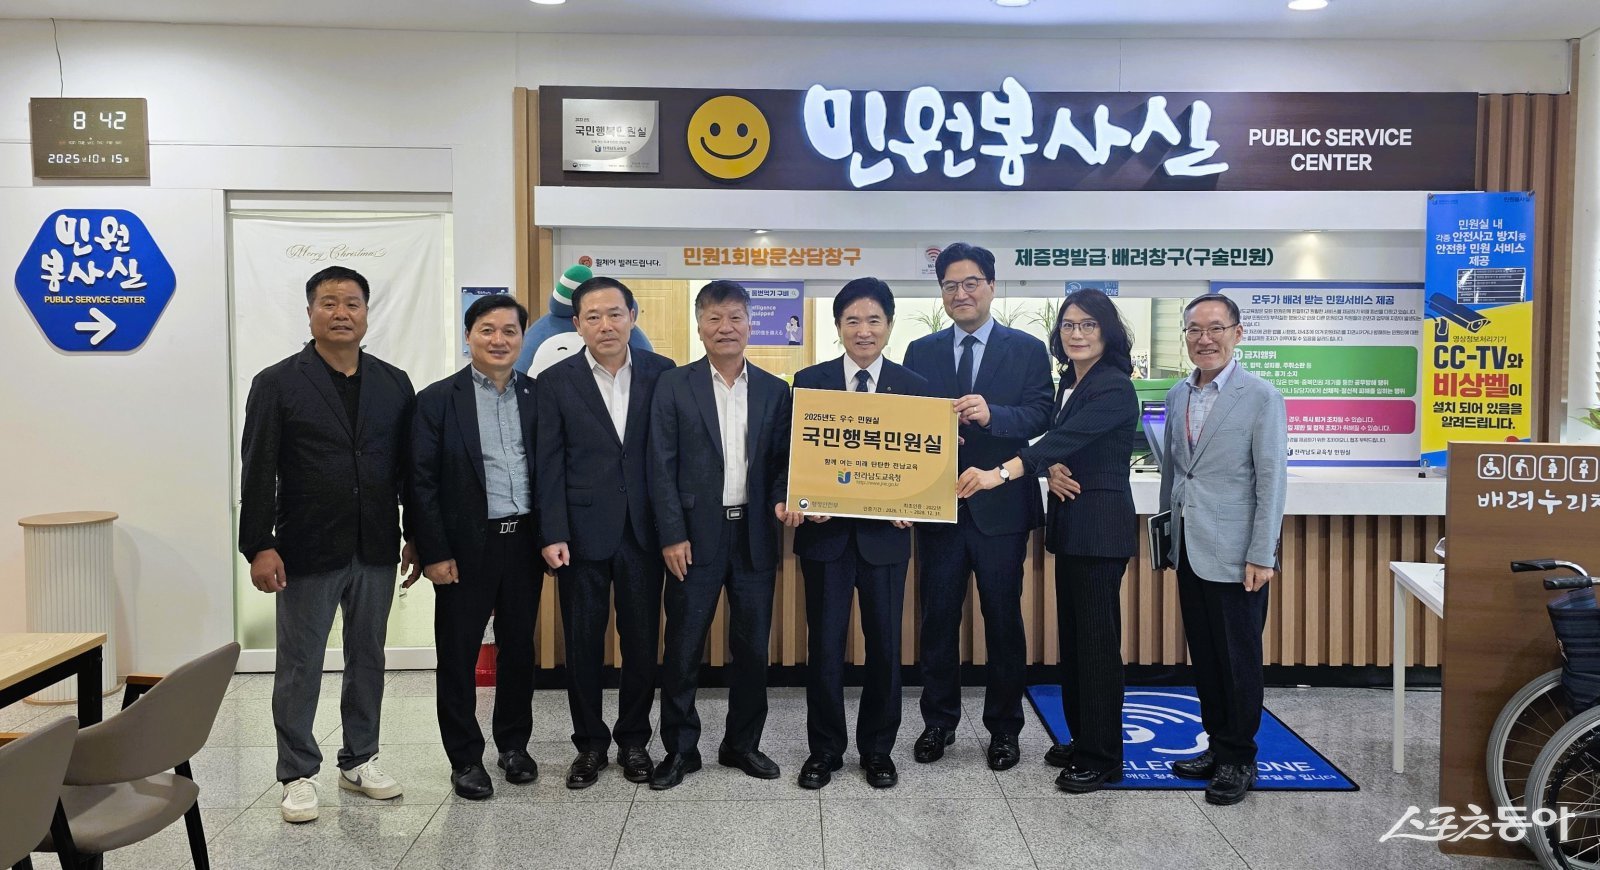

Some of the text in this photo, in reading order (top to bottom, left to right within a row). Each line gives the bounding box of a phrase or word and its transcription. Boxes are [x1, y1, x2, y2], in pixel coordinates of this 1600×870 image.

[73, 111, 127, 130] 8 42
[803, 76, 1229, 188] 민원봉사실
[1248, 128, 1412, 146] PUBLIC SERVICE
[1291, 153, 1372, 171] CENTER
[1458, 218, 1503, 230] 민원실 내
[55, 215, 130, 257] 민원
[1452, 231, 1494, 242] 안전사고
[286, 244, 388, 264] Merry Christmas
[1435, 243, 1526, 255] 안전한 민원 서비스
[595, 258, 661, 267] 휠체어 빌려드립니다.
[683, 247, 861, 267] 민원1회방문상담창구
[1469, 255, 1490, 266] 제공
[40, 249, 147, 292] 봉사실
[44, 296, 146, 304] PUBLIC SERVICE CENTER
[1251, 294, 1394, 305] 모두가 배려 받는 민원서비스 제공
[1453, 335, 1507, 343] 영상정보처리기기
[1244, 350, 1277, 359] 금지행위
[1434, 345, 1524, 370] CC-TV와
[1434, 373, 1522, 398] 비상벨이
[1433, 401, 1522, 415] 설치 되어 있음을
[804, 412, 880, 425] 2025년도 우수 민원실
[1441, 416, 1516, 429] 알려드립니다.
[802, 426, 943, 455] 국민행복민원실
[824, 458, 837, 466] 함께
[839, 459, 853, 467] 여는
[892, 462, 918, 471] 전남교육
[853, 471, 901, 482] 전라남도교육청
[1257, 761, 1316, 772] ONE
